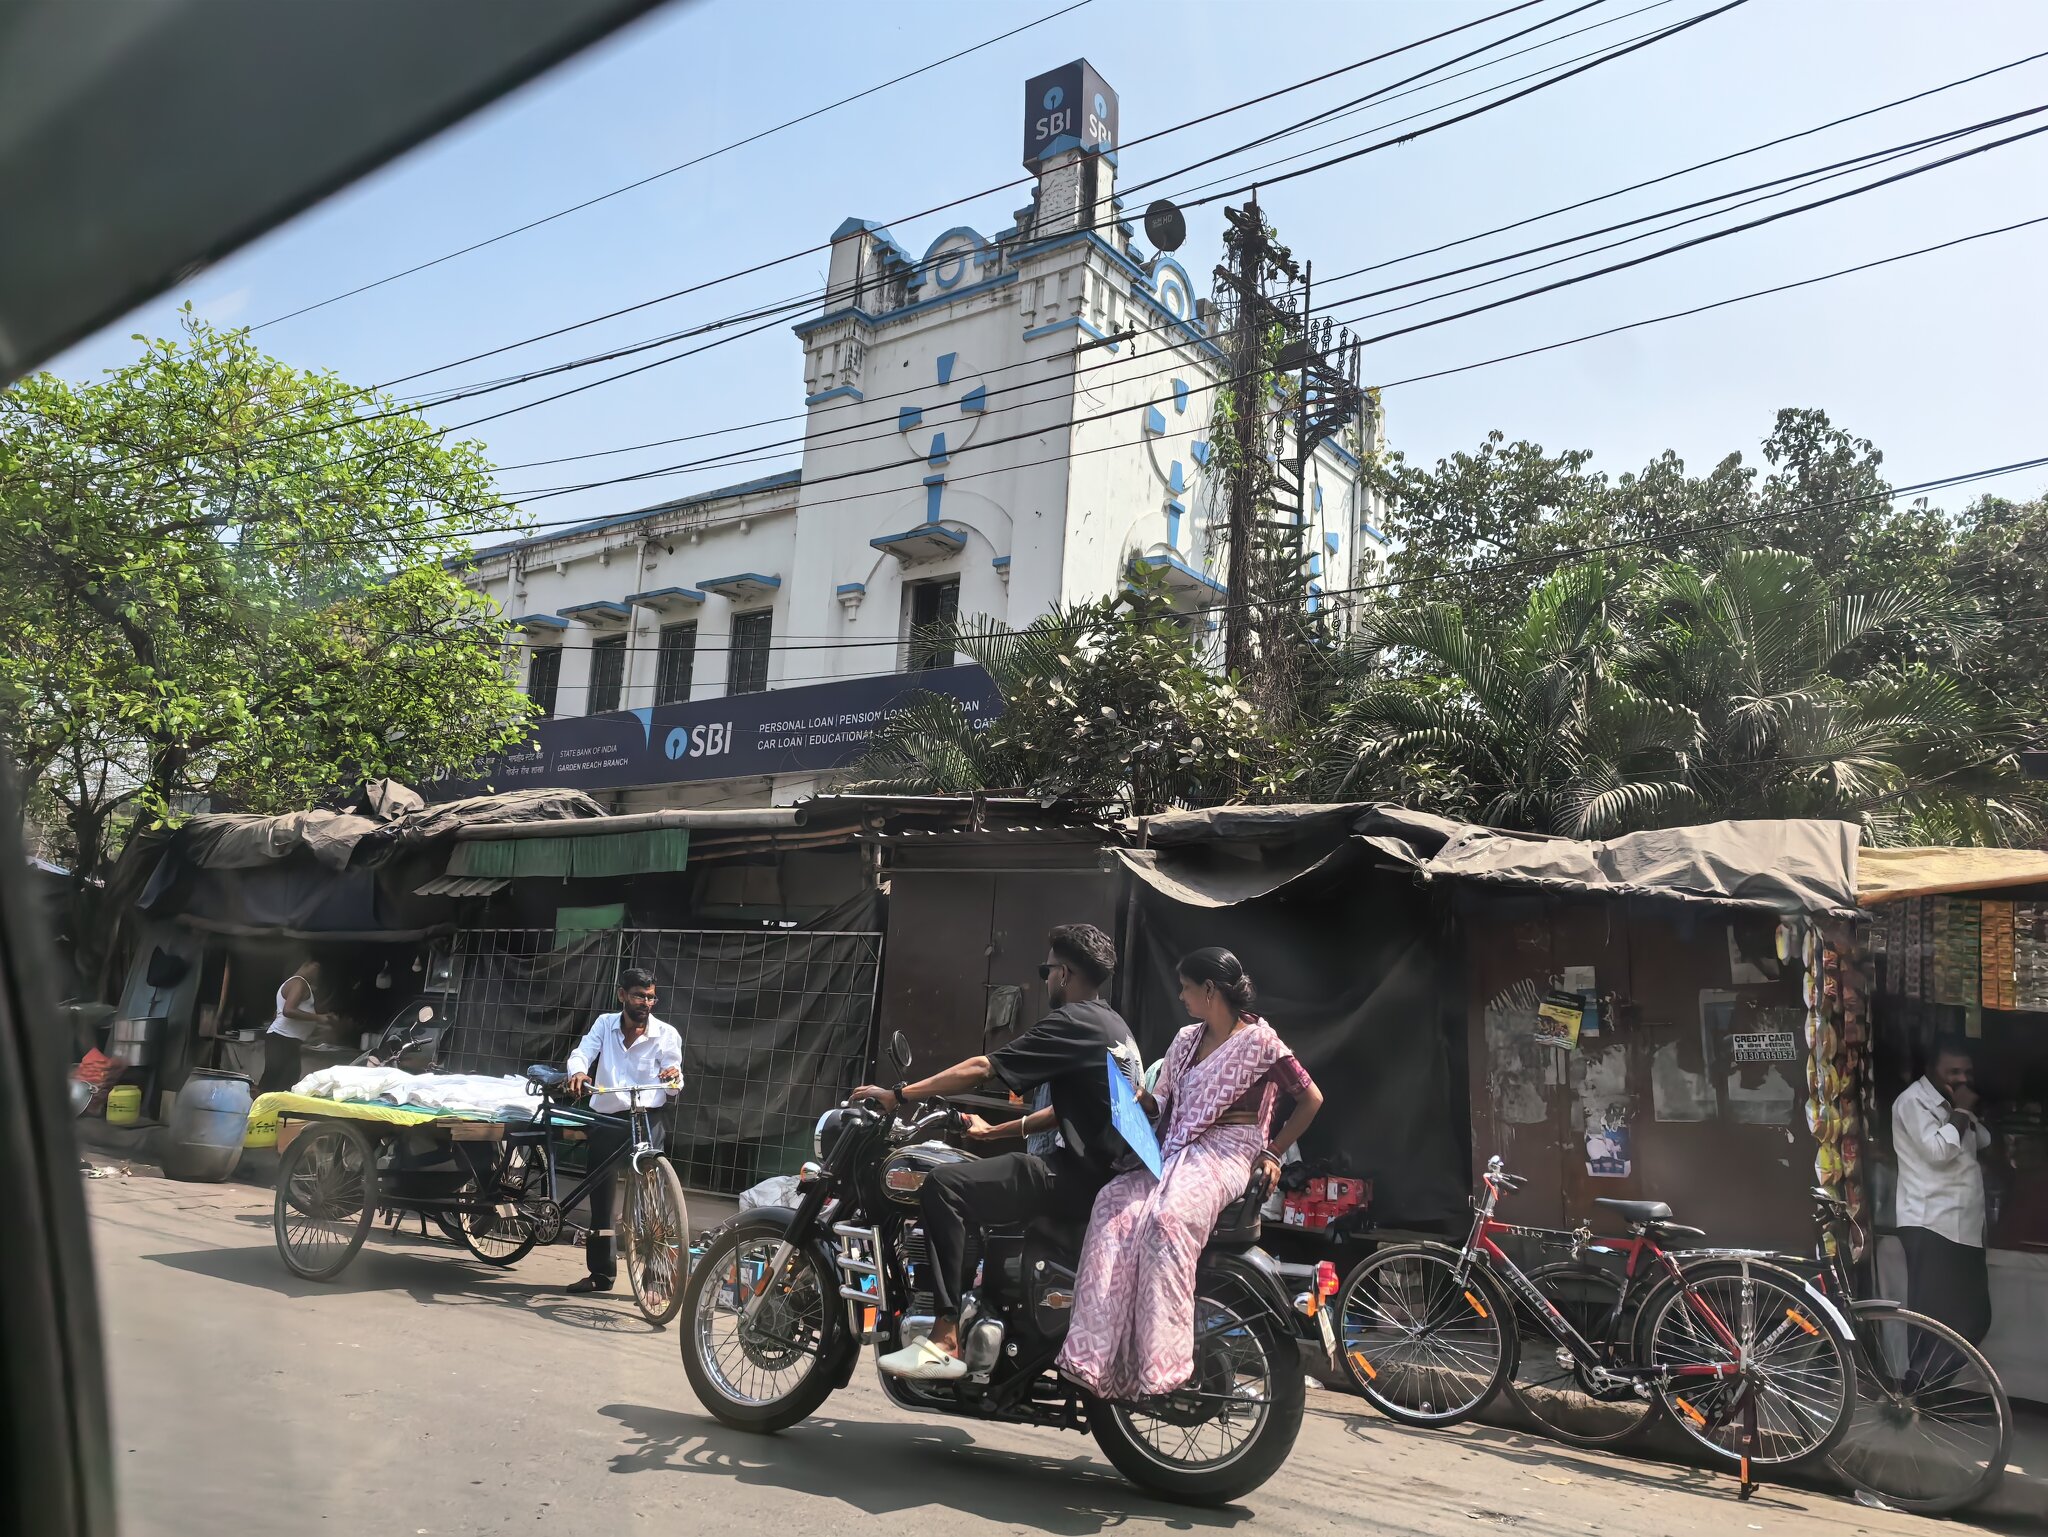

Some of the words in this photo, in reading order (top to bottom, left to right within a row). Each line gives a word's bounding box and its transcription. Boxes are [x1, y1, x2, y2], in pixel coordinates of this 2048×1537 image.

[1035, 108, 1071, 141] SBI
[1089, 113, 1112, 142] SBI
[759, 720, 806, 733] PERSONAL
[808, 716, 834, 729] LOAN
[839, 711, 881, 725] PENSION
[689, 721, 733, 758] SBI
[757, 738, 776, 751] CAR
[778, 735, 803, 749] LOAN
[809, 730, 873, 745] EDUCATIONAL
[560, 750, 576, 758] STATE
[576, 748, 592, 757] BANK
[593, 746, 601, 755] OF
[601, 744, 618, 754] INDIA
[557, 763, 581, 772] GARDEN
[582, 761, 603, 770] REACH
[603, 758, 629, 768] BRANCH
[1734, 1035, 1766, 1043] CREDIT
[1768, 1034, 1792, 1042] CARD
[1505, 1269, 1567, 1334] HERCULES
